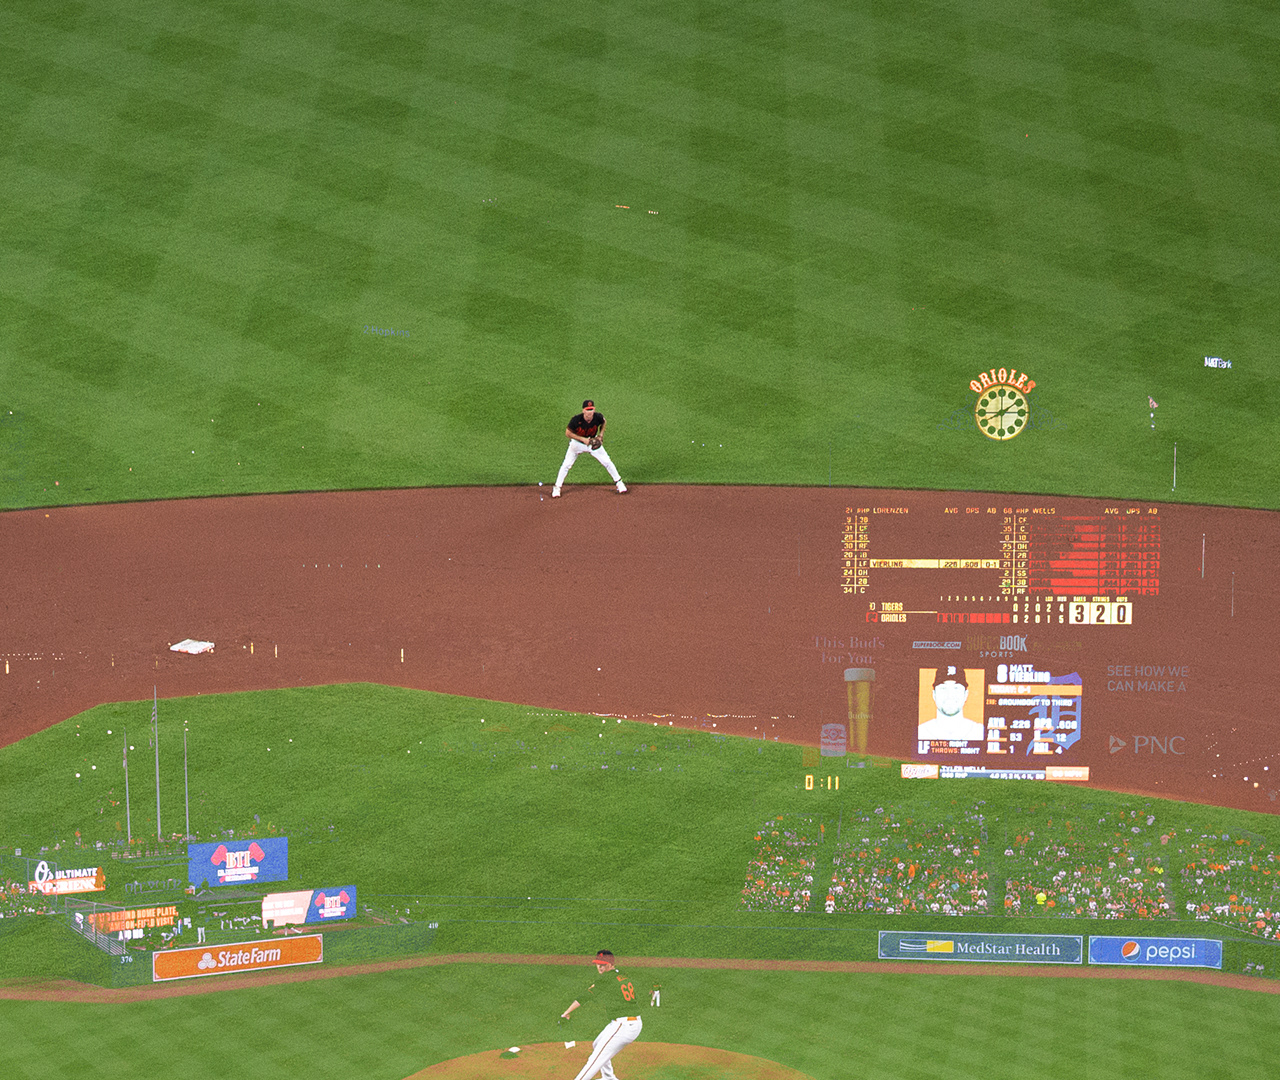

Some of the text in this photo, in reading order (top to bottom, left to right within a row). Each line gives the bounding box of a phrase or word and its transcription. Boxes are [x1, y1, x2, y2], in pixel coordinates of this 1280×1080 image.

[969, 367, 1036, 393] ORIOLES
[881, 602, 903, 611] TIGERS
[881, 614, 906, 622] ORIOLES
[1075, 604, 1126, 622] 3 2 0
[850, 637, 885, 648] Bud's
[1107, 665, 1188, 677] SEE HOW WE
[1107, 680, 1186, 692] CAN MAKE A
[1056, 733, 1066, 742] 12
[1055, 746, 1062, 754] 4
[1132, 736, 1185, 754] PNC
[225, 851, 250, 868] BTI
[55, 868, 98, 879] ULTIMATE
[137, 908, 155, 918] HOME
[157, 906, 179, 917] PLATE,
[156, 916, 175, 926] VISIT
[957, 941, 1060, 956] MedStar Health
[1145, 943, 1196, 962] pepsi
